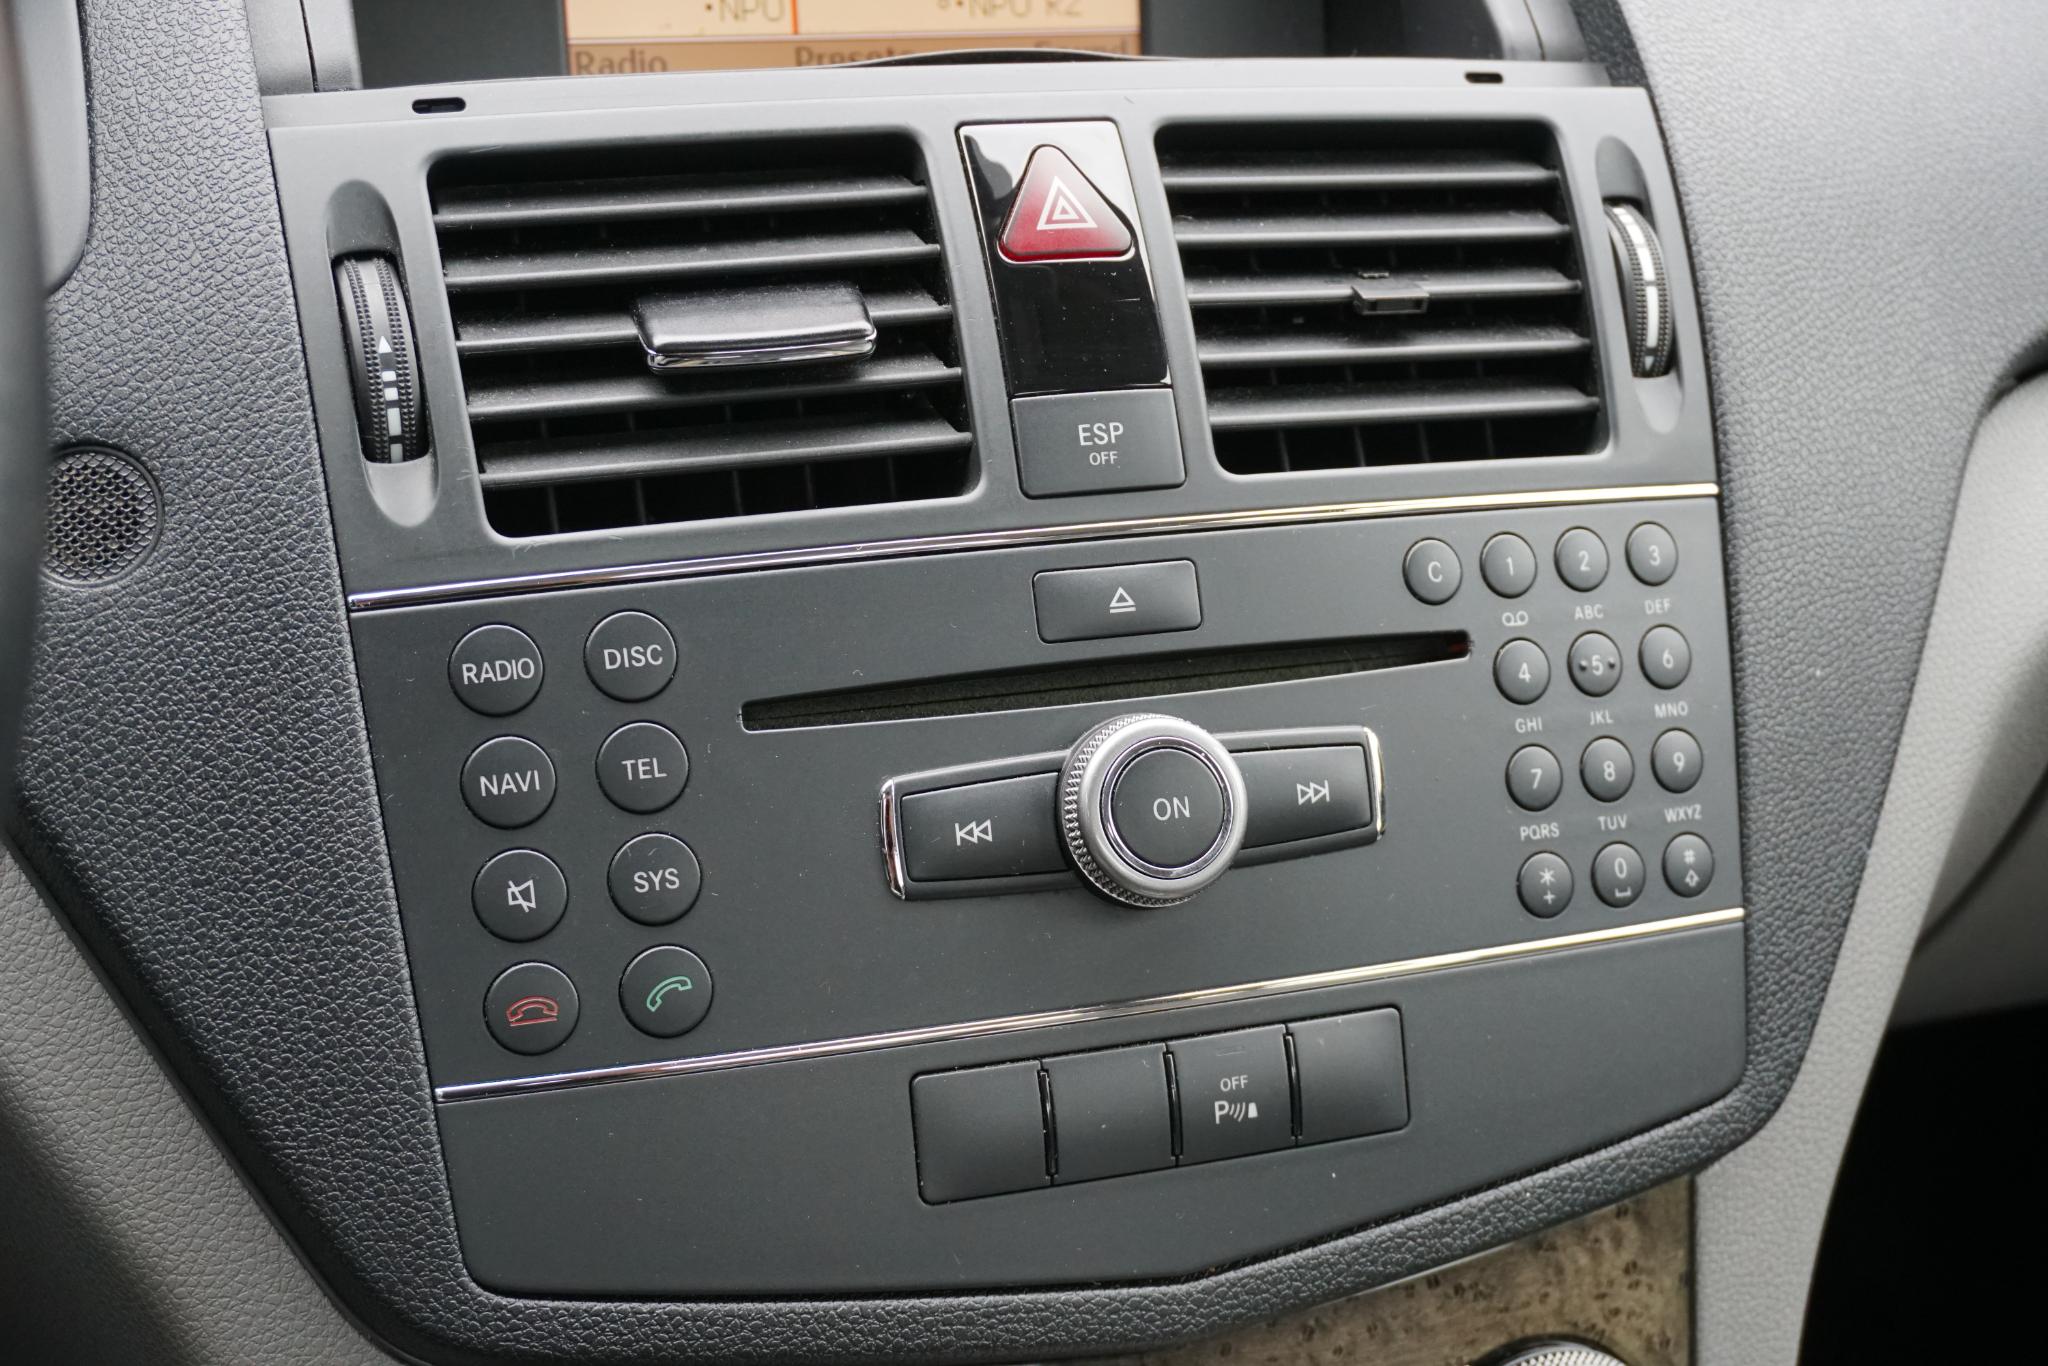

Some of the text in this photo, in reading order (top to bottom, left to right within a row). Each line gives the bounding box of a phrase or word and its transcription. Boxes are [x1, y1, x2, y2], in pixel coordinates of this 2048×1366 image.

[574, 49, 668, 76] Radio
[1078, 421, 1124, 446] ESP
[1089, 450, 1118, 466] OFF
[1578, 550, 1590, 571] 2
[1649, 544, 1661, 566] 3
[1428, 560, 1443, 583] C
[1506, 556, 1514, 575] 1
[1574, 603, 1604, 620] ABC
[1644, 598, 1671, 615] DEF
[603, 644, 663, 670] DISC
[1591, 654, 1604, 675] 5
[1662, 648, 1674, 668] 6
[461, 656, 536, 685] RADIO
[1518, 662, 1531, 682] 4
[1590, 710, 1613, 725] JKL
[1654, 701, 1688, 718] MNO
[1515, 716, 1543, 733] GHI
[621, 757, 668, 781] TEL
[1603, 760, 1616, 781] 8
[1673, 751, 1685, 771] 9
[479, 769, 540, 797] NAVI
[1530, 767, 1543, 789] 7
[1153, 795, 1191, 821] ON
[1664, 804, 1701, 823] WXYZ
[1519, 822, 1560, 841] PQRS
[1597, 814, 1627, 830] TUV
[633, 867, 680, 893] SYS
[1220, 1074, 1248, 1092] OFF
